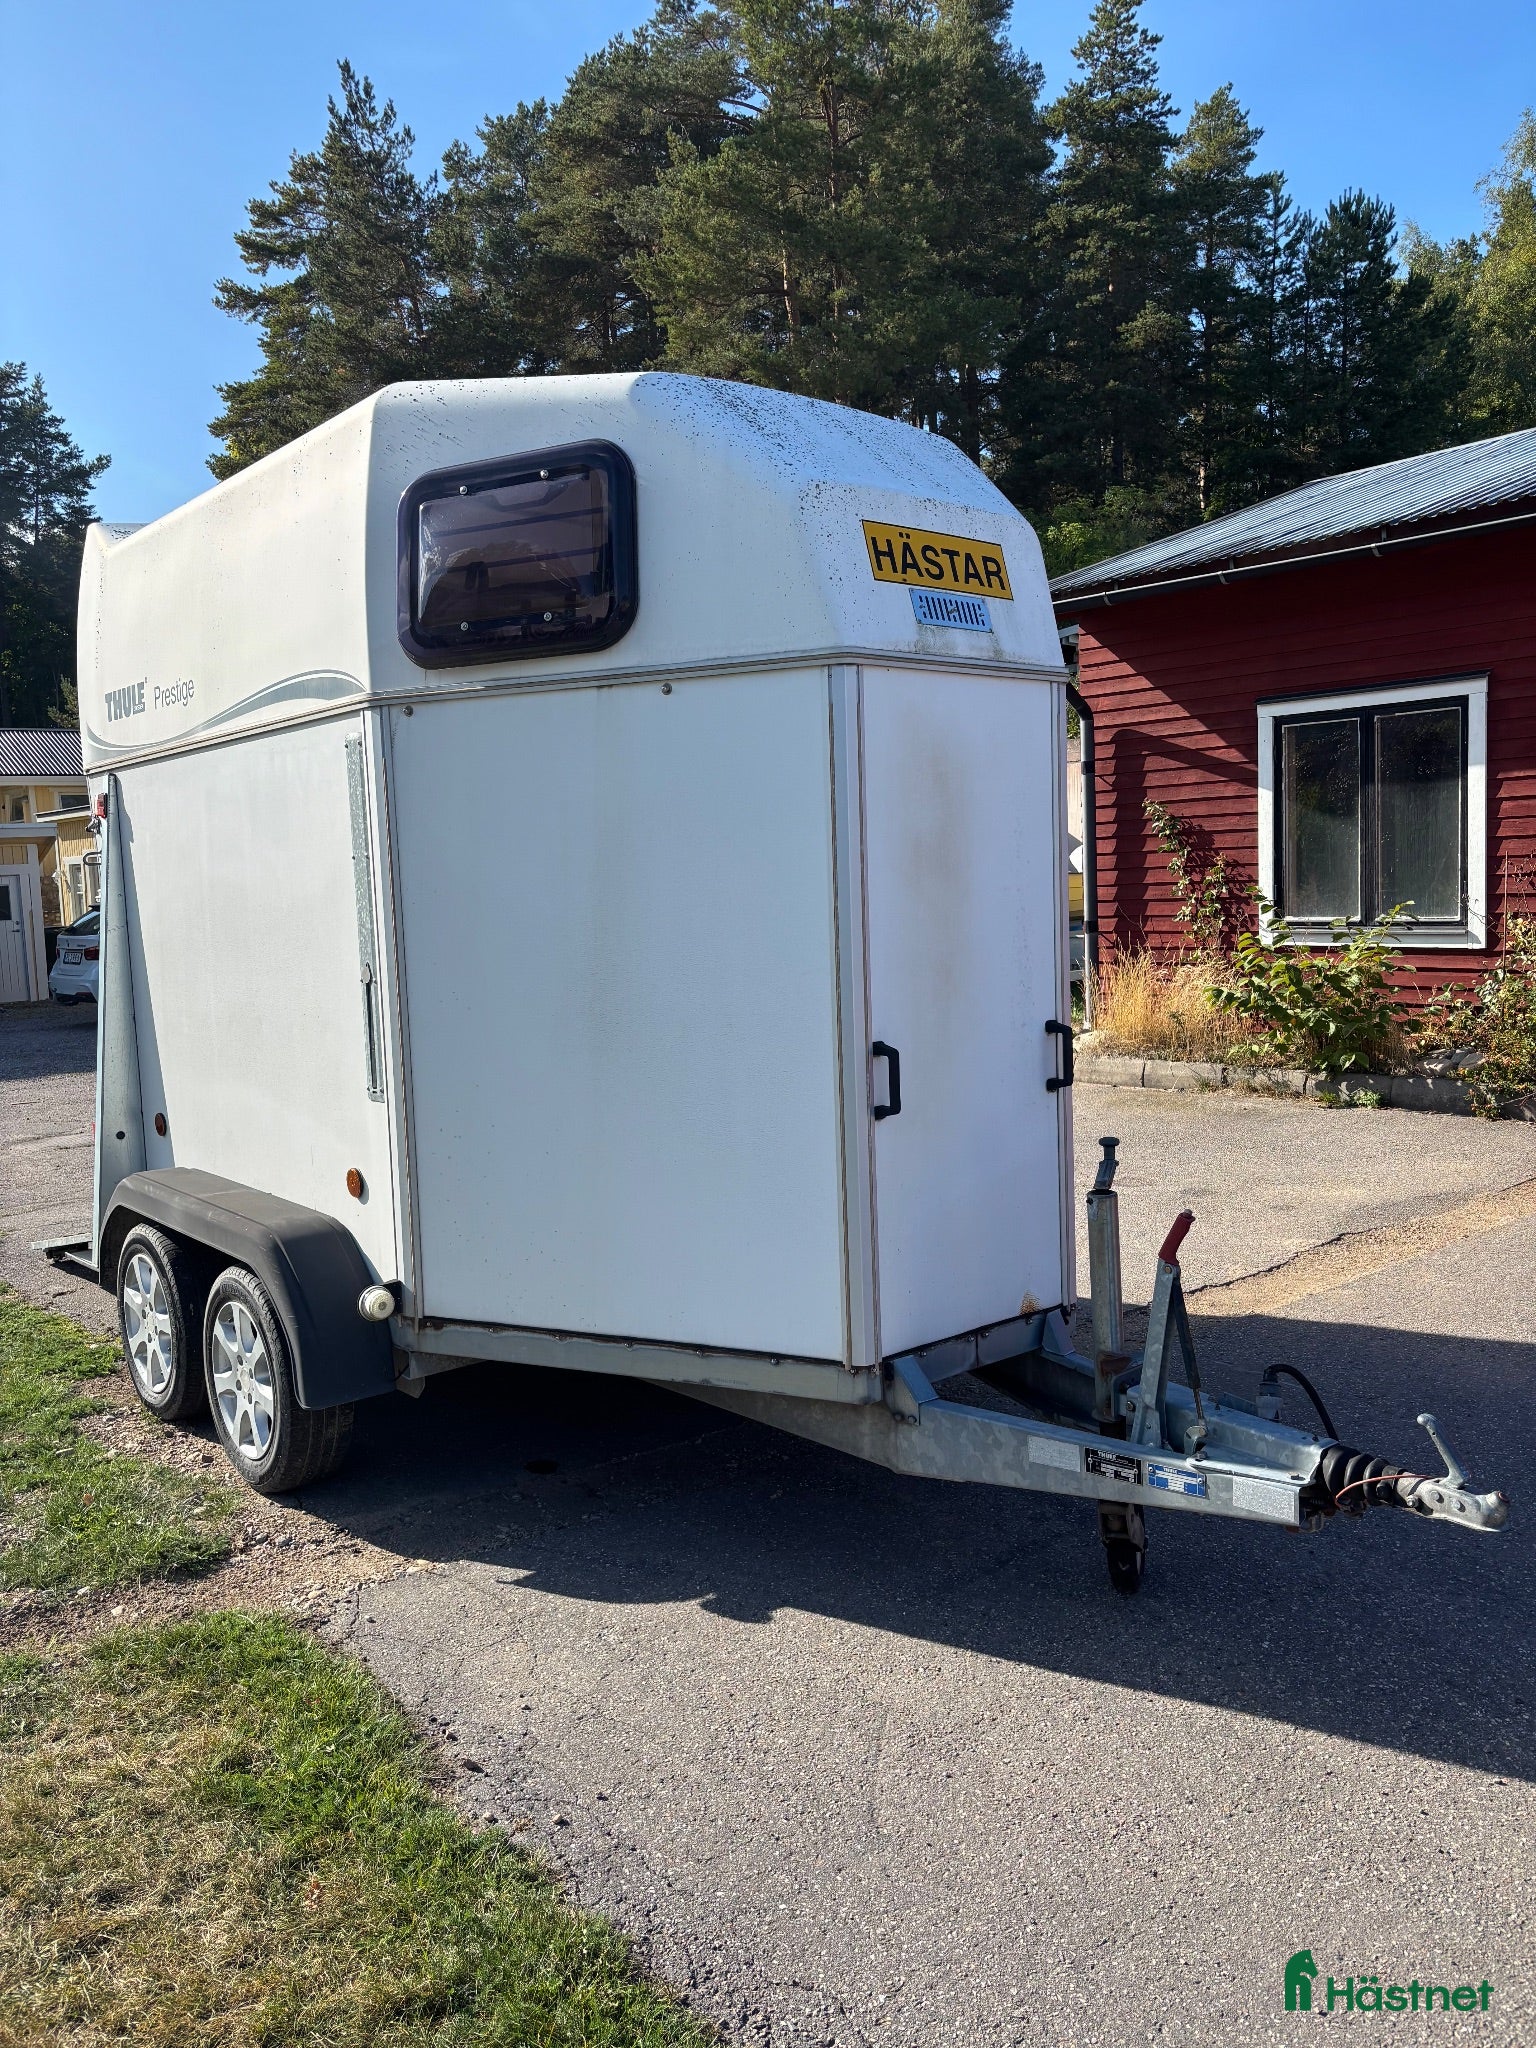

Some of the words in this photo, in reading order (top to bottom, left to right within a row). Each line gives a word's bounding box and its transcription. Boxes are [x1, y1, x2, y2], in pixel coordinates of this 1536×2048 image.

[871, 532, 1006, 591] HÄSTAR
[105, 681, 146, 723] THULE
[153, 678, 195, 710] Prestige
